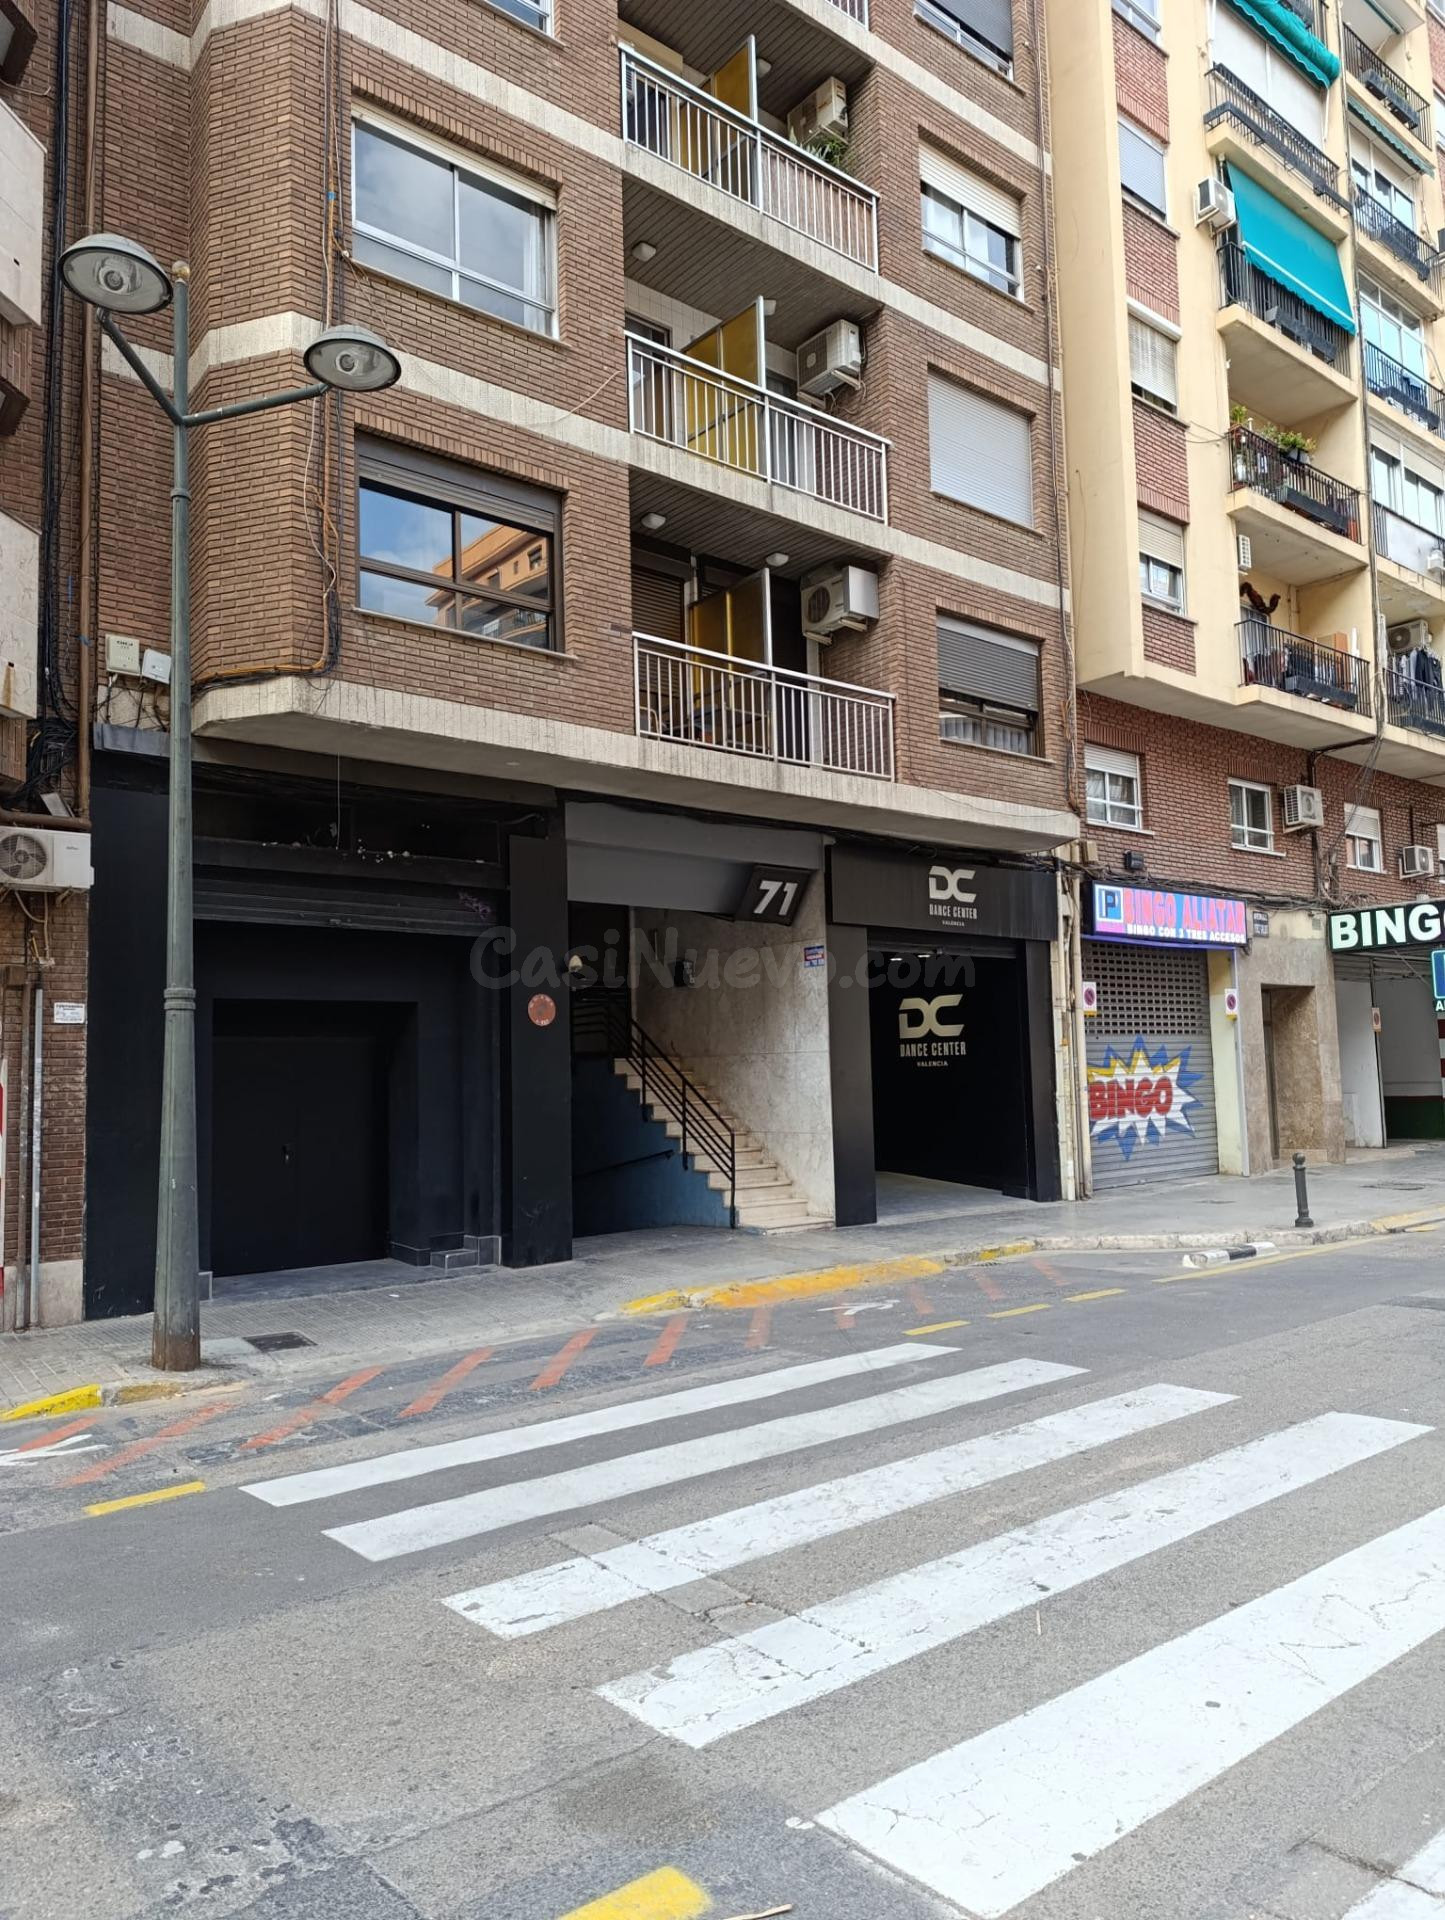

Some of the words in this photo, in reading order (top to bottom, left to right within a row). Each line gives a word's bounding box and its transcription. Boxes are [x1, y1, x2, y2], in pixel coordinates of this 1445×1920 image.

[753, 880, 798, 916] 71
[929, 865, 977, 903] DC
[929, 903, 951, 917] DANCE
[952, 905, 978, 920] CENTER
[1123, 886, 1177, 929] BINGO
[1126, 922, 1156, 936] BINGO
[1330, 903, 1445, 950] BING
[899, 993, 965, 1039] DC
[900, 1042, 928, 1057] DANCE
[931, 1041, 967, 1056] CENTER
[917, 1060, 949, 1068] VALENCIA
[1088, 1075, 1173, 1120] BINGO
